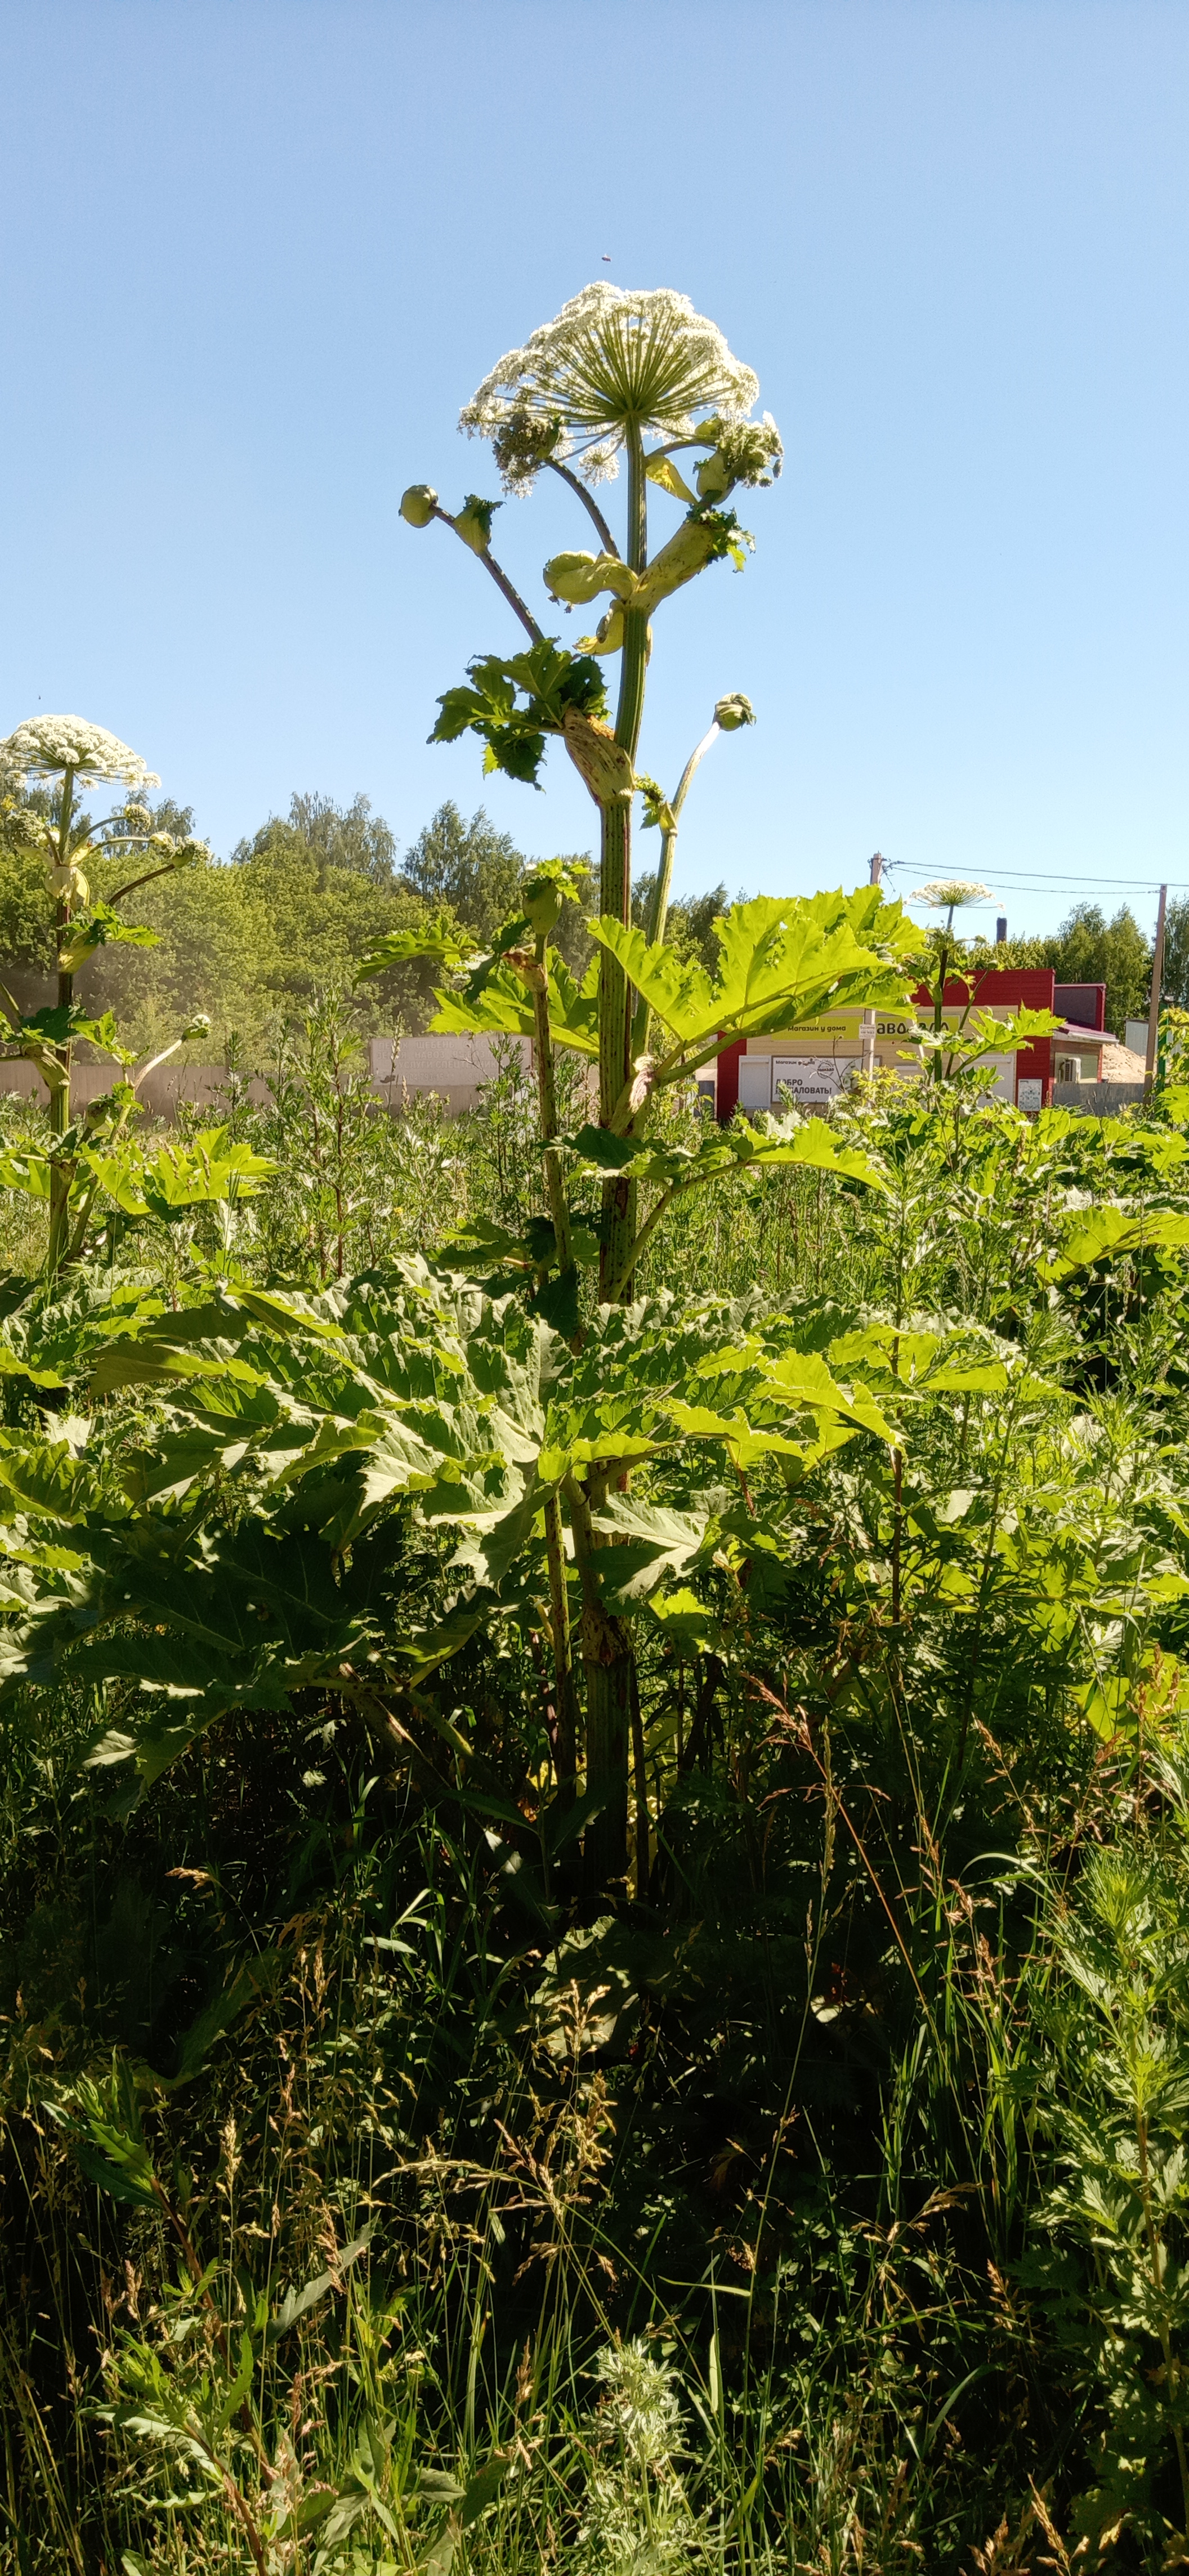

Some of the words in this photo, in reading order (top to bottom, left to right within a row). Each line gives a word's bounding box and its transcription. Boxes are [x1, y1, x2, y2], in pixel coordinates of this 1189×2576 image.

[416, 1041, 455, 1049] ЩЕБЕНЬ
[399, 1061, 432, 1069] УСЛУГИ
[435, 1060, 498, 1069] СПЕЦТЕХНИК
